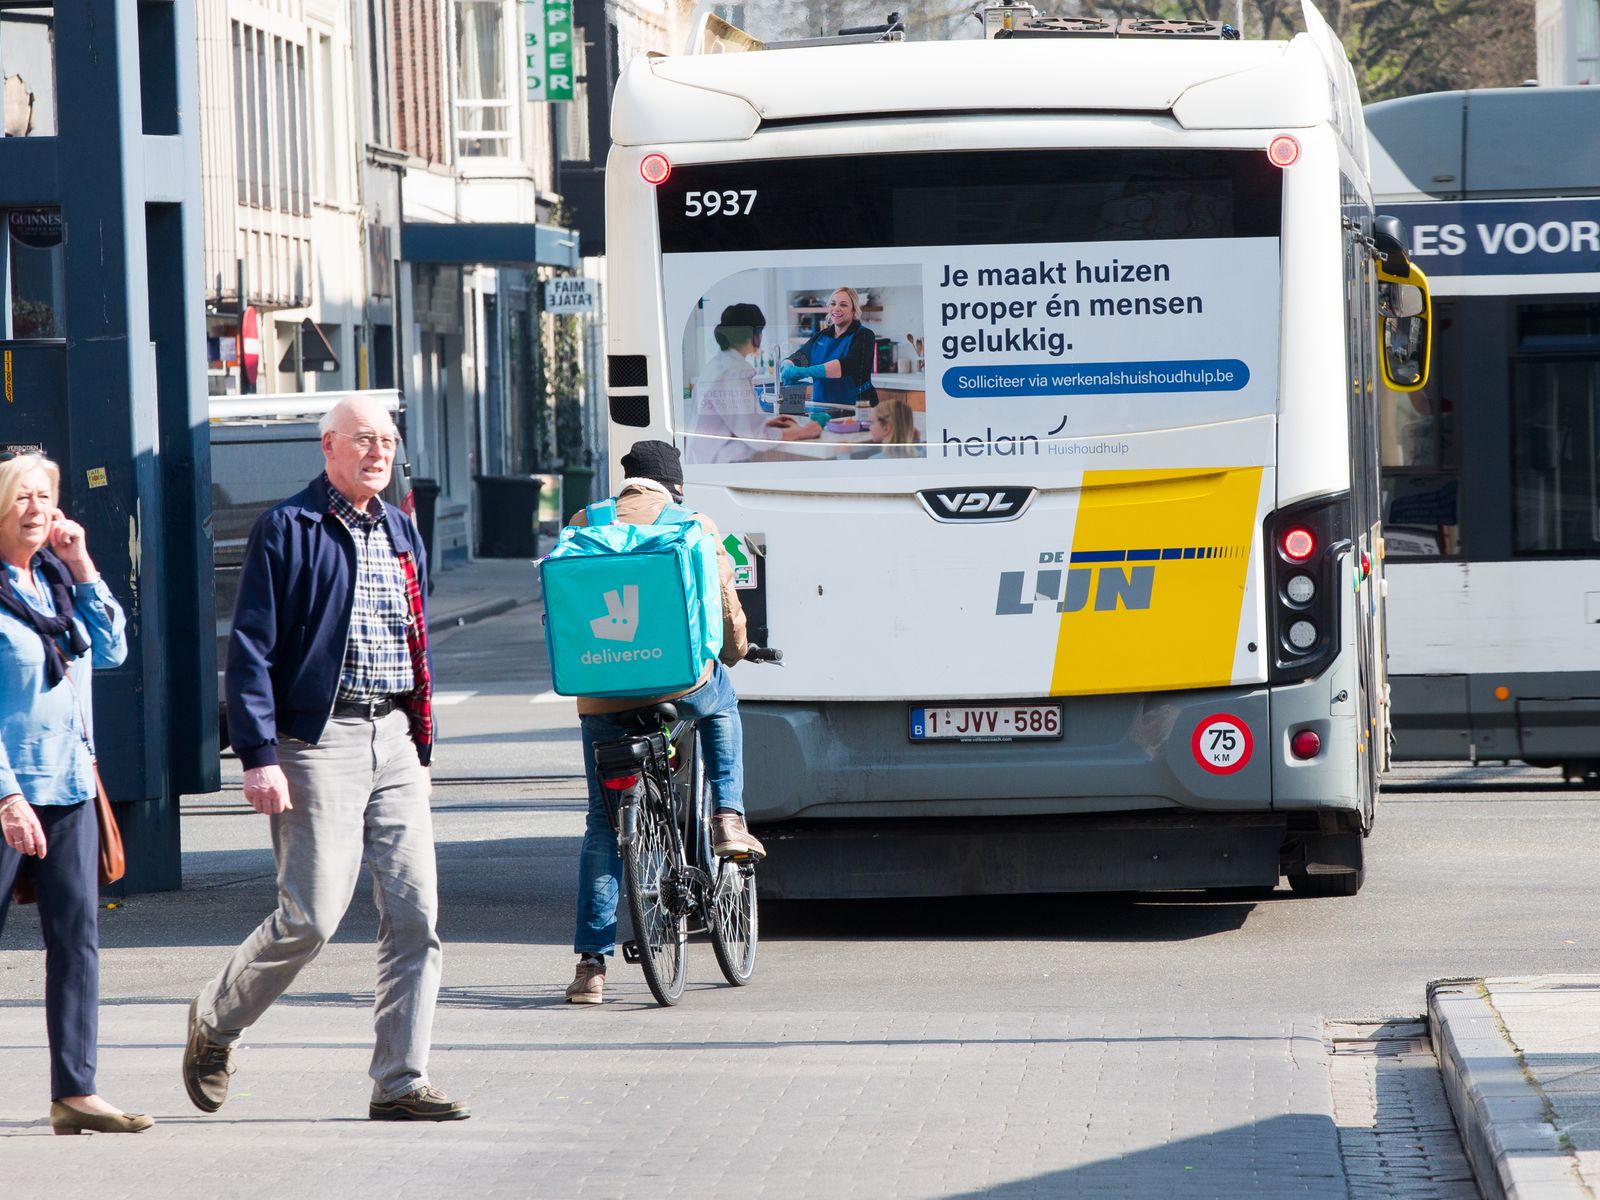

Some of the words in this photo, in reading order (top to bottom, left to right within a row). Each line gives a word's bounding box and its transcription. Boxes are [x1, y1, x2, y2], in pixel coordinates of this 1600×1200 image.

[546, 0, 571, 90] PPER
[685, 190, 758, 217] 5937
[11, 213, 62, 225] GUINNES
[1409, 224, 1467, 256] ES
[1476, 221, 1600, 255] VOOR
[940, 264, 969, 287] Je
[977, 261, 1067, 286] maakt
[1075, 259, 1170, 283] huizen
[555, 281, 585, 292] FAIM
[941, 300, 1037, 326] proper
[1046, 293, 1080, 317] én
[1090, 295, 1203, 316] mensen
[941, 327, 1073, 359] gelukkig.
[958, 375, 1025, 389] Solliciteer
[1029, 374, 1048, 387] via
[1052, 369, 1234, 386] werkenalshuishoudhulp.be
[942, 427, 1039, 457] helan
[1048, 442, 1129, 456] Huishoudhulp
[937, 492, 1014, 512] VDL
[1039, 552, 1064, 564] DE
[995, 566, 1155, 616] LIJN
[581, 648, 663, 665] deliveroo
[915, 725, 923, 735] B
[1209, 729, 1236, 750] 75
[1214, 754, 1230, 762] KM
